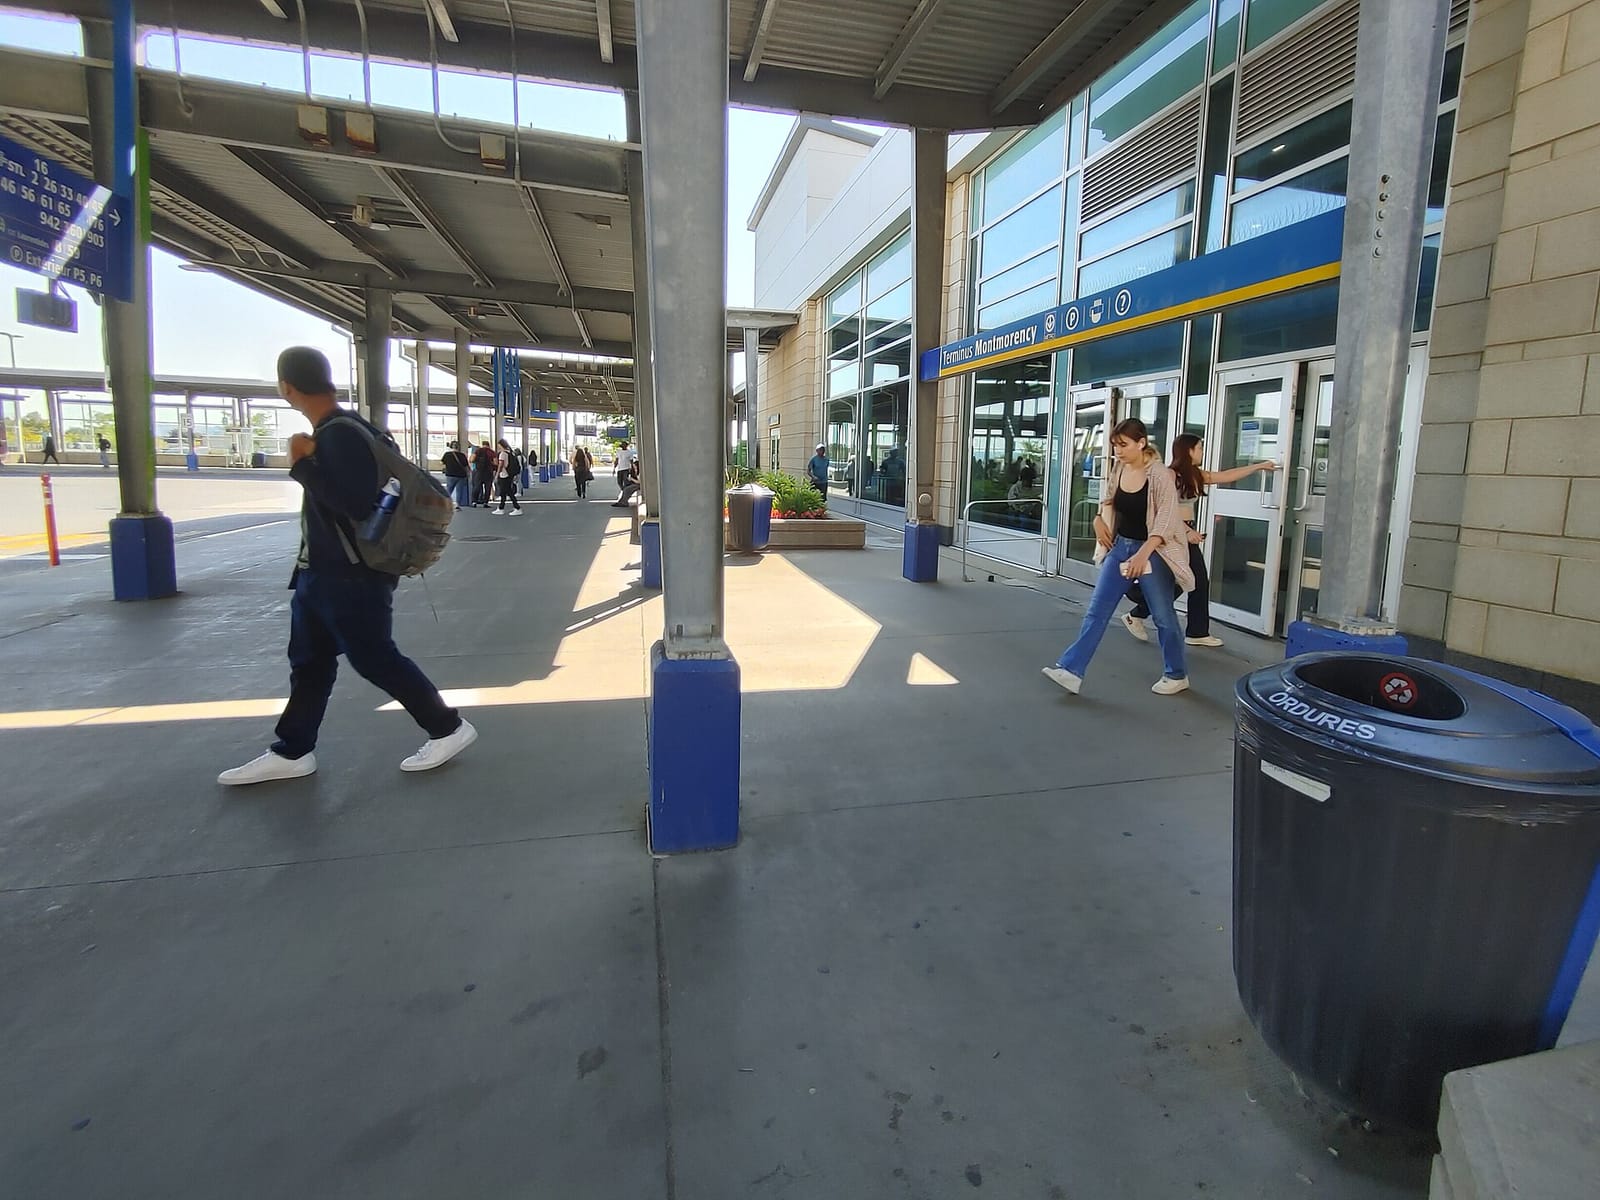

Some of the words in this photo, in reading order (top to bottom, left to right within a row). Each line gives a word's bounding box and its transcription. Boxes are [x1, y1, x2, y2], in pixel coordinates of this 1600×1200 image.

[7, 160, 26, 177] STL
[31, 171, 39, 185] 2
[43, 177, 57, 193] 26
[60, 184, 74, 201] 33
[34, 159, 48, 175] 16
[1, 177, 16, 194] 46
[21, 185, 36, 202] 56
[40, 194, 53, 210] 61
[57, 202, 71, 217] 65
[40, 211, 60, 231] 942
[87, 231, 105, 248] 903
[90, 273, 103, 288] P6
[943, 345, 974, 366] Terminus
[974, 325, 1038, 357] Montmorency
[1268, 691, 1376, 740] ORDURES
